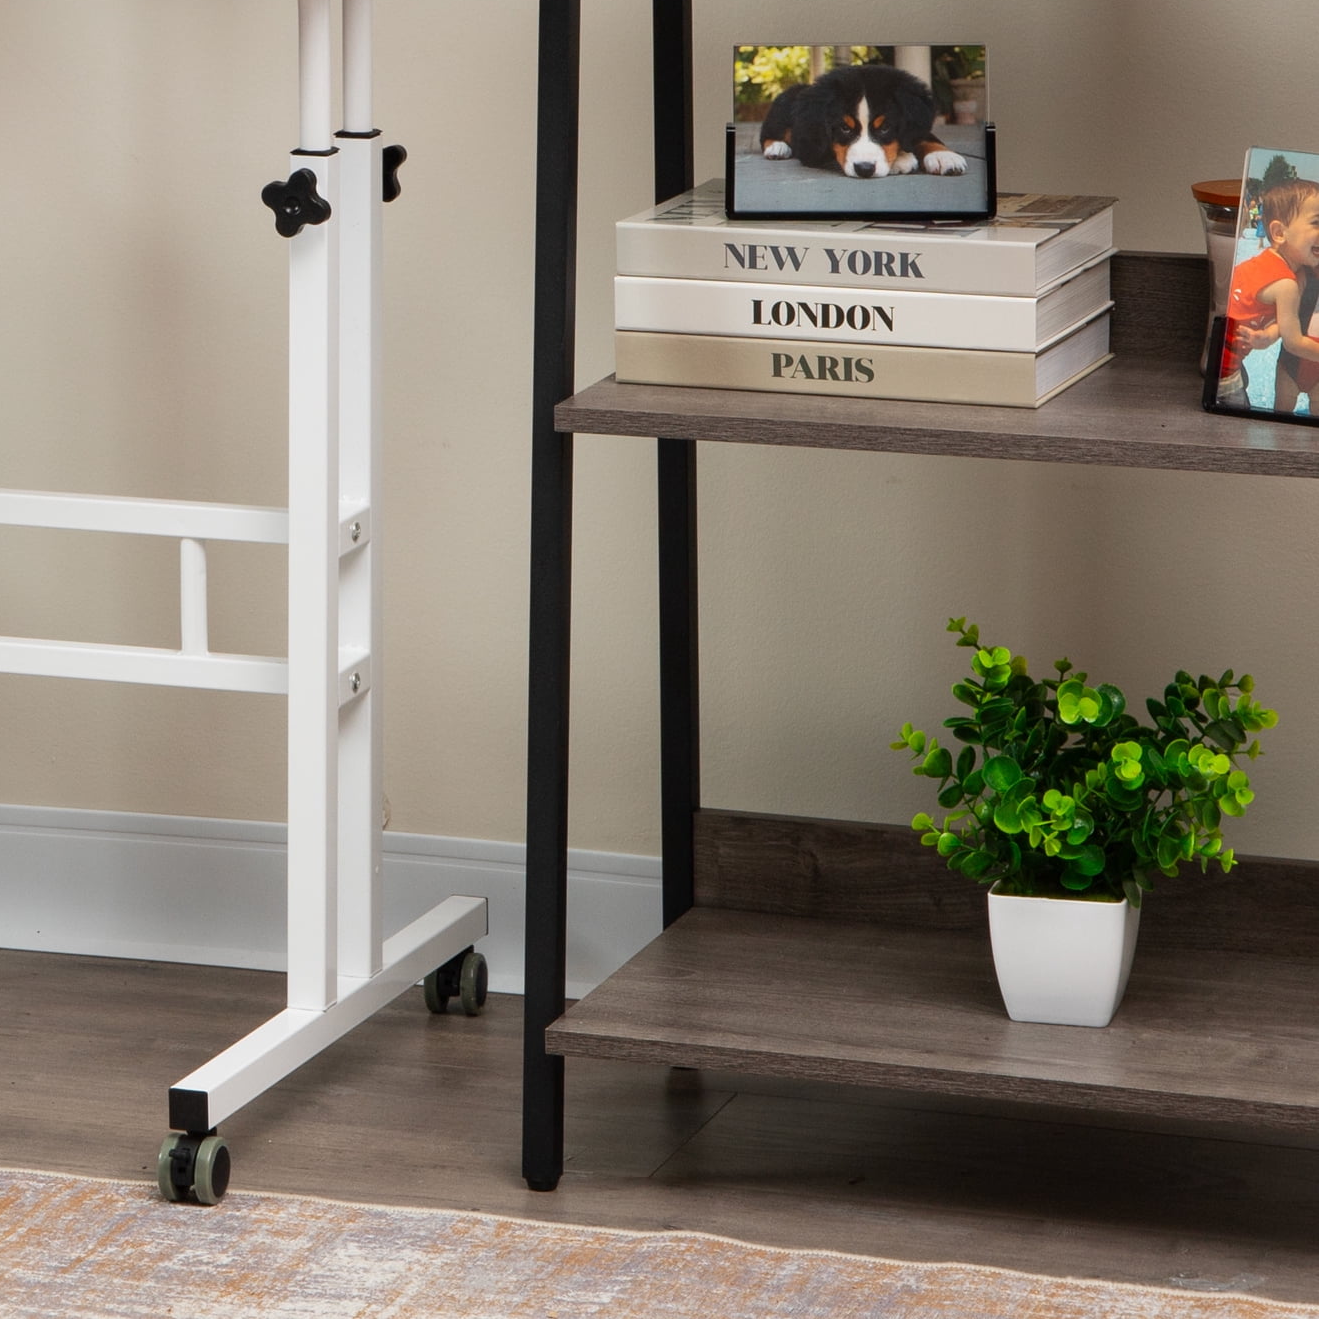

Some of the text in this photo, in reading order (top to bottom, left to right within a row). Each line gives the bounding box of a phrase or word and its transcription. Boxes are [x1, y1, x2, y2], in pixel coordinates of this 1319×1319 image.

[724, 242, 926, 279] NEW YORK
[751, 299, 894, 332] LONDON
[771, 352, 876, 384] PARIS
